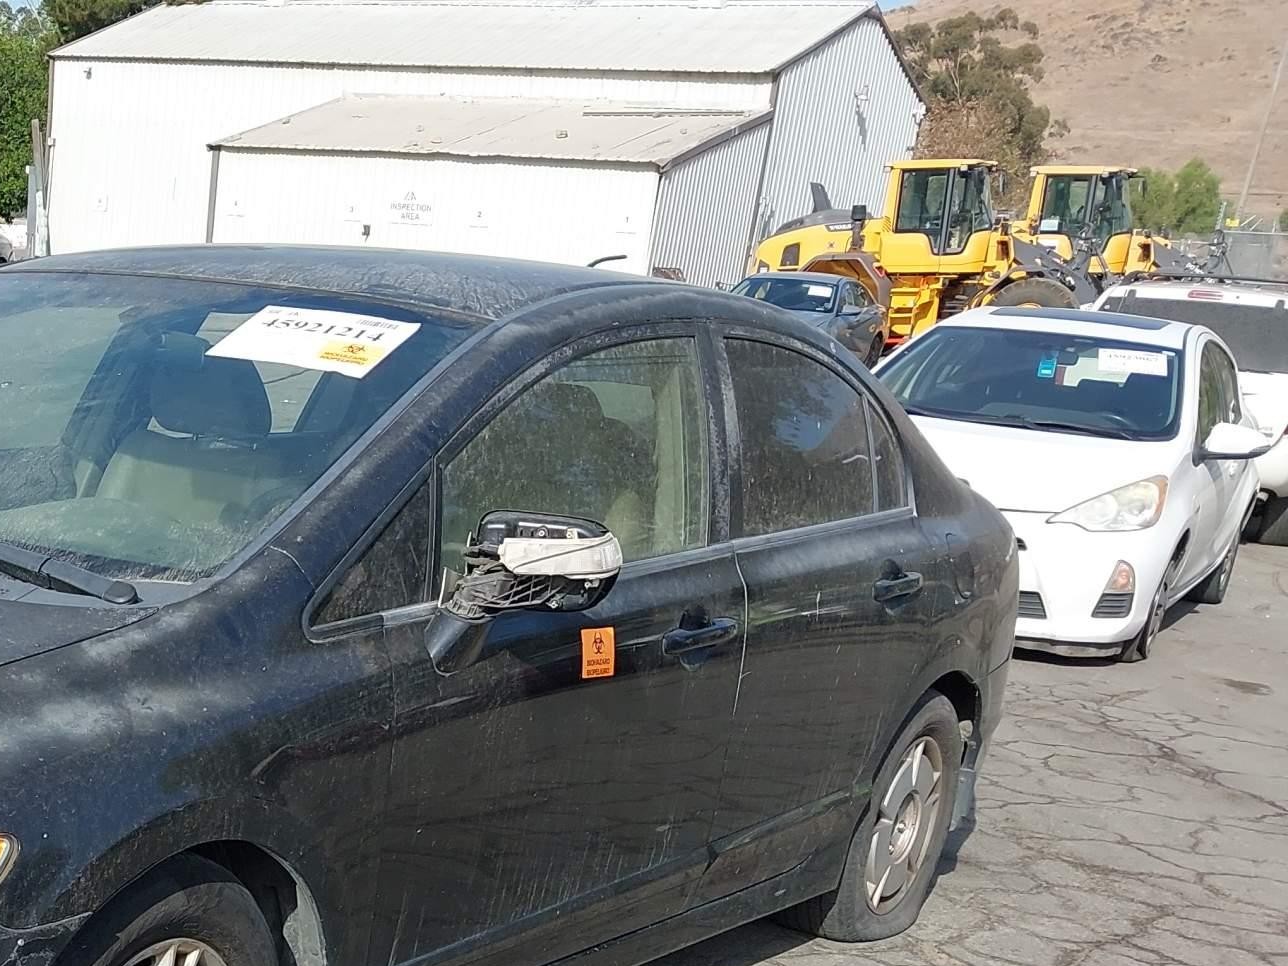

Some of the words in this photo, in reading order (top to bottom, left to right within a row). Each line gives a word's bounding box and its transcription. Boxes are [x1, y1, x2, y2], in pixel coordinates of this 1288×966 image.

[390, 202, 432, 212] INSPECTION
[400, 212, 420, 220] AREA
[261, 318, 386, 342] 45921214
